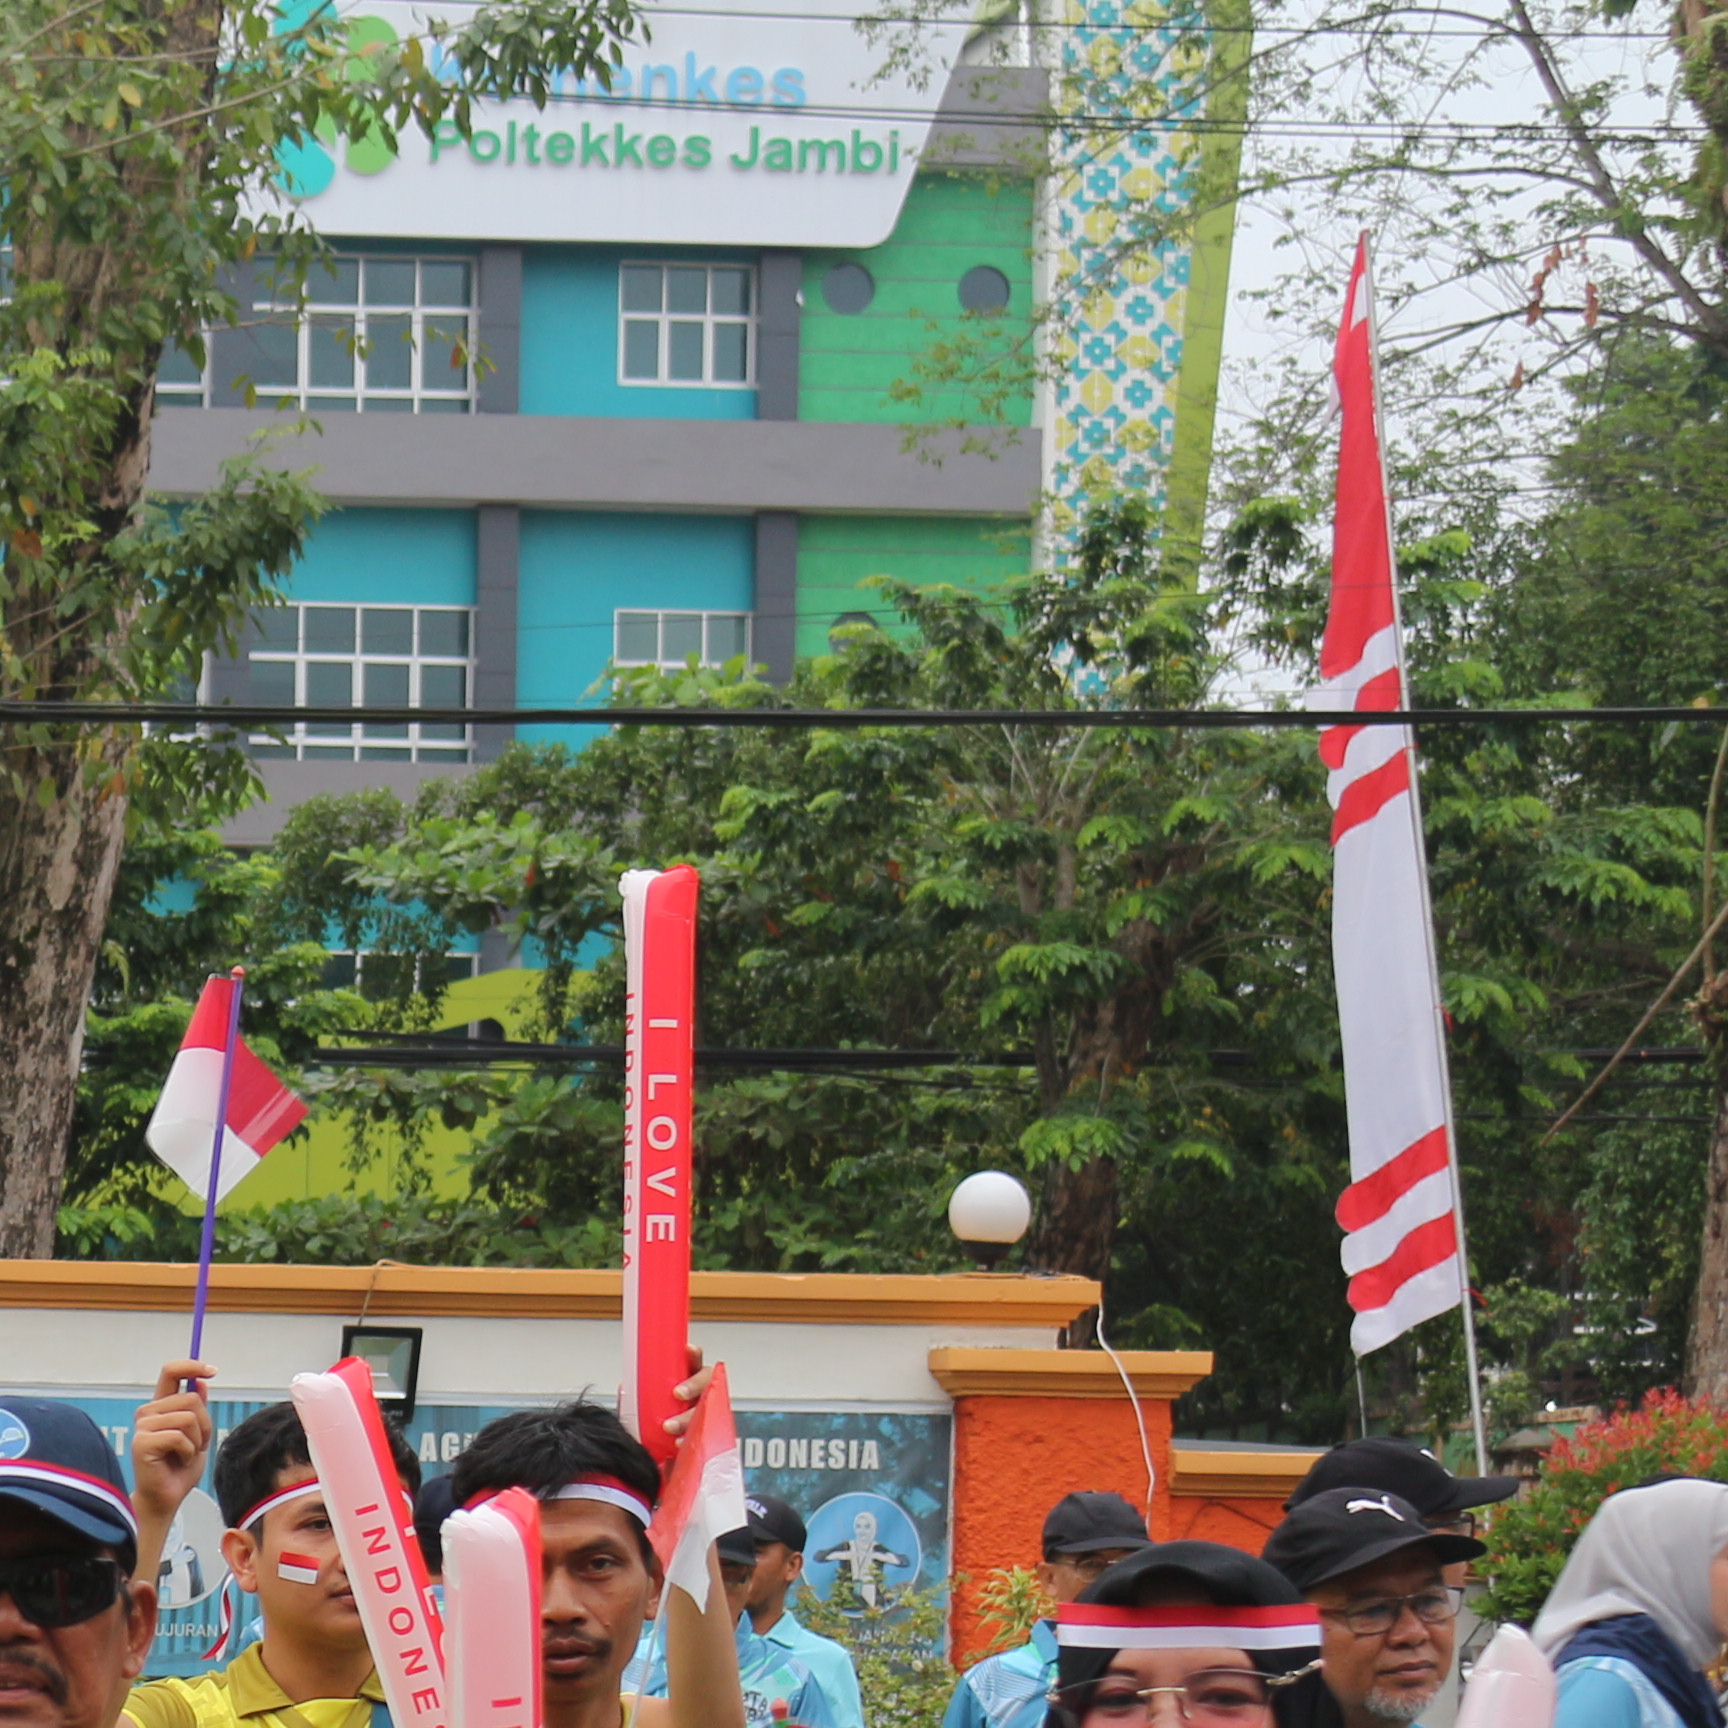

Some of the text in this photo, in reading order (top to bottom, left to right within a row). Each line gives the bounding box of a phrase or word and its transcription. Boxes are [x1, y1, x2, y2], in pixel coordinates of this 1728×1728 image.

[429, 119, 900, 173] Poltekkes Jambi
[646, 1073, 678, 1244] LOVE
[736, 1437, 881, 1471] DONESIA
